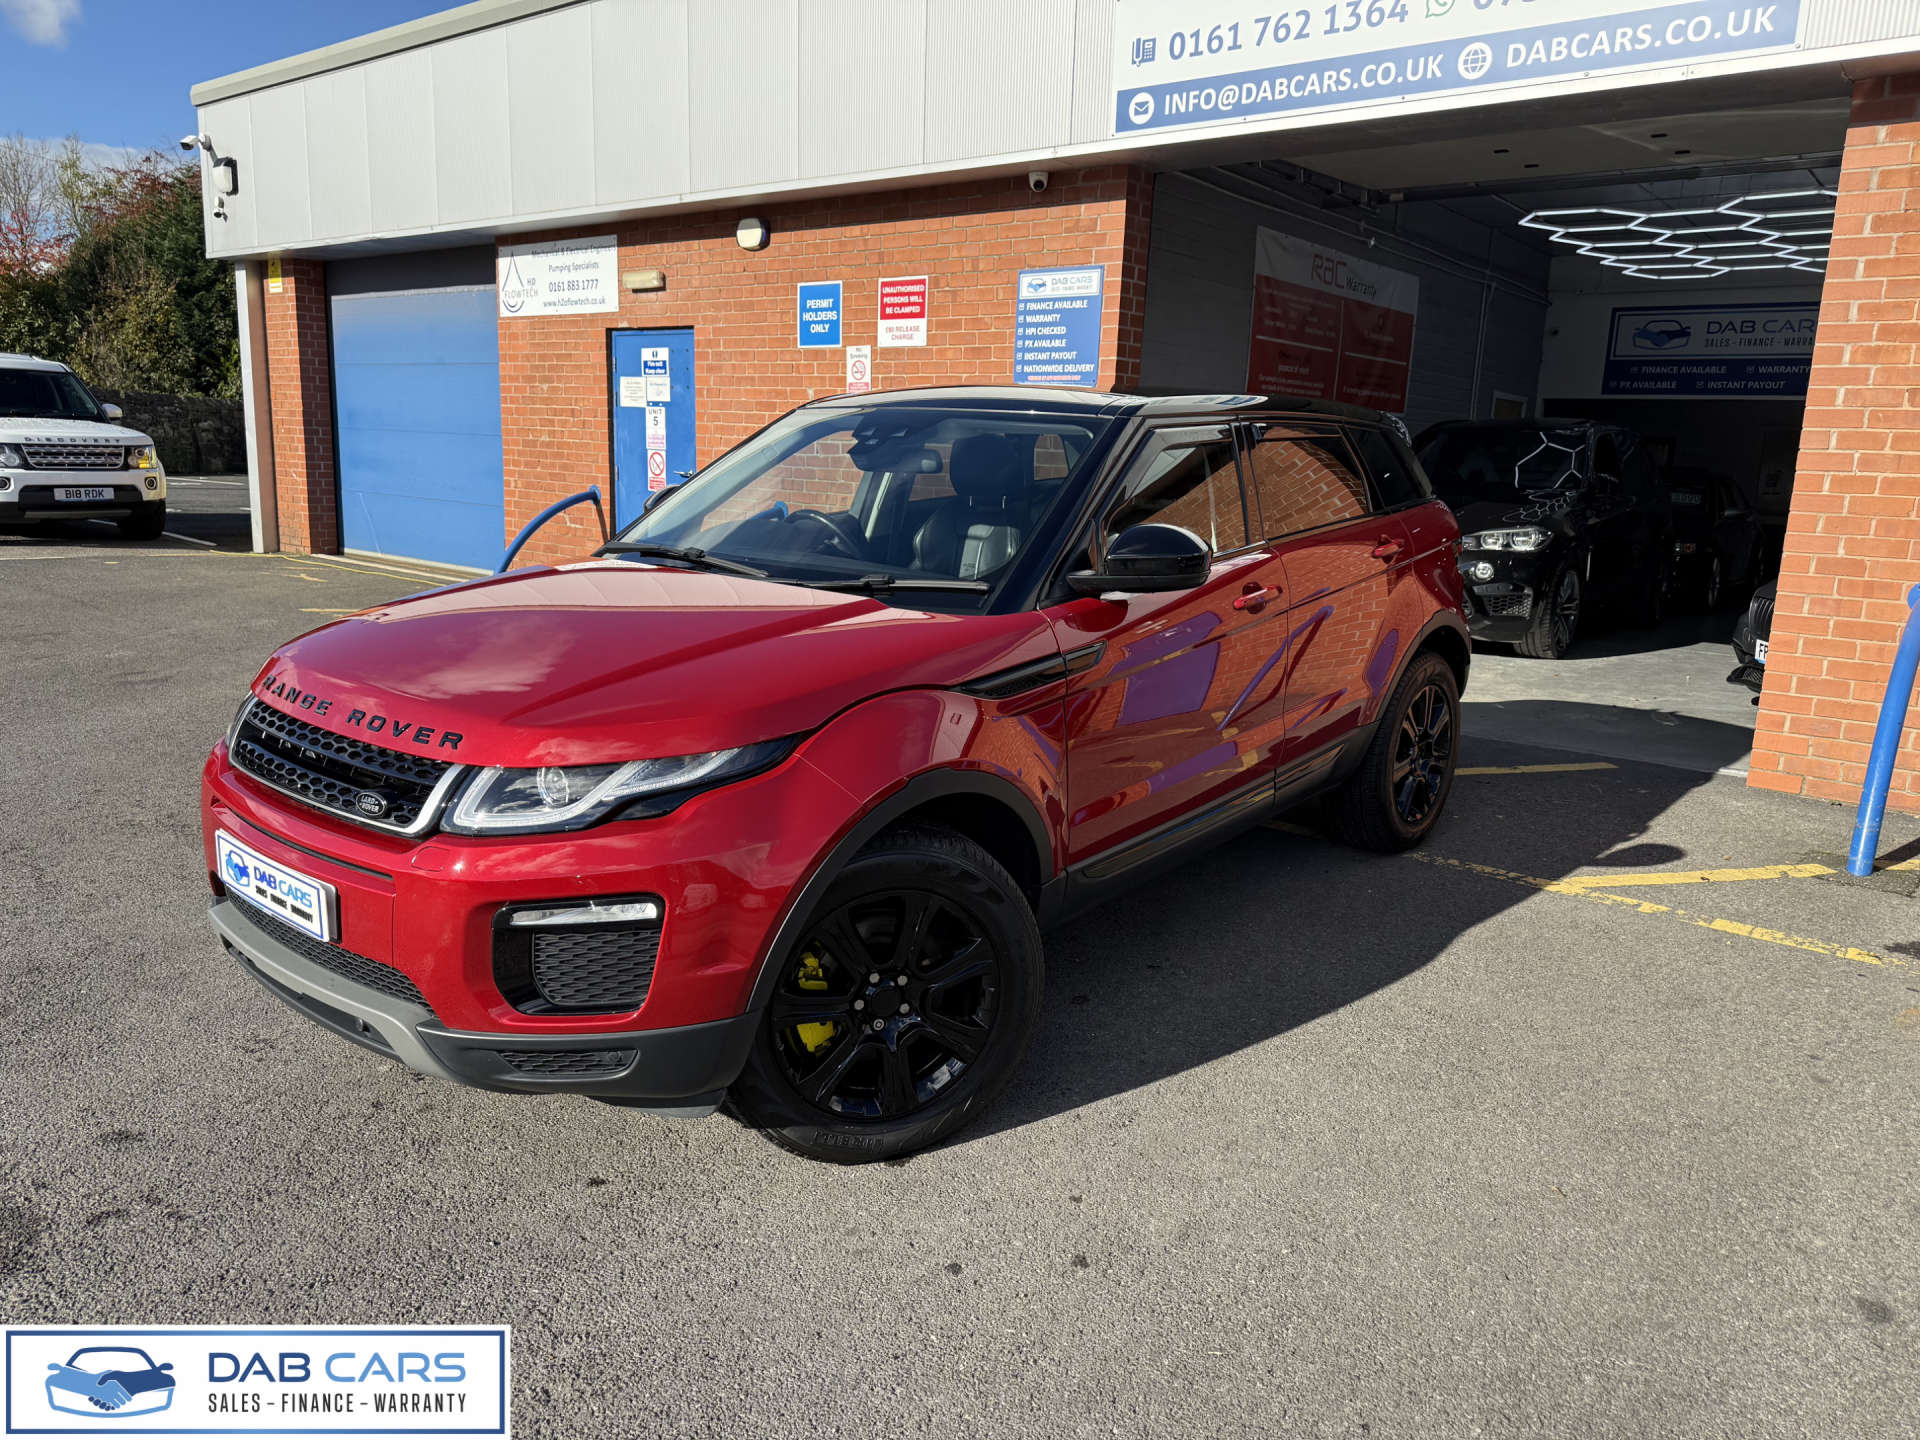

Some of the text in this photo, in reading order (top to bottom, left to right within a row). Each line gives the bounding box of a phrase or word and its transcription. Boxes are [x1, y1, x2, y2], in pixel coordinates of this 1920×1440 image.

[1168, 0, 1409, 60] 0161 762 1364
[1506, 5, 1777, 68] DABCARS.CO.UK
[1164, 54, 1444, 115] INFO@DABCARS.CO.UK
[1312, 253, 1348, 289] RAC
[548, 278, 599, 293] 0161 883 1777
[882, 284, 924, 294] UNAUTHORISED
[504, 288, 538, 299] FLOWTECH
[806, 298, 834, 309] PERMIT
[883, 296, 909, 304] PERSONS
[1026, 300, 1088, 310] FINANCE AVAILABLE
[894, 306, 920, 314] CLAMPED
[802, 310, 838, 322] HOLDERS
[1026, 314, 1060, 323] WARRANTY
[810, 323, 830, 334] ONLY
[1026, 326, 1066, 336] HPI CHECKED
[1706, 319, 1815, 334] DAB CAR
[1025, 339, 1066, 348] PX AVAILABLE
[1704, 338, 1730, 348] SALES
[1738, 336, 1774, 348] FINANCE
[1784, 336, 1814, 347] WARRA
[1024, 351, 1077, 360] INSTANT PAYOUT
[1024, 364, 1095, 373] NATIONWIDE DELIVERY
[1640, 366, 1728, 374] FINANCE AVAILABLE
[1758, 365, 1811, 374] WARRANTY
[1632, 380, 1678, 390] AVAILABLE
[1706, 380, 1786, 390] INSTANT PAYOUT
[653, 416, 659, 426] 5
[24, 436, 121, 444] DISCOVERY
[84, 487, 105, 499] RDK
[262, 674, 464, 751] RANGE ROVER
[254, 866, 312, 909] DAB CARS
